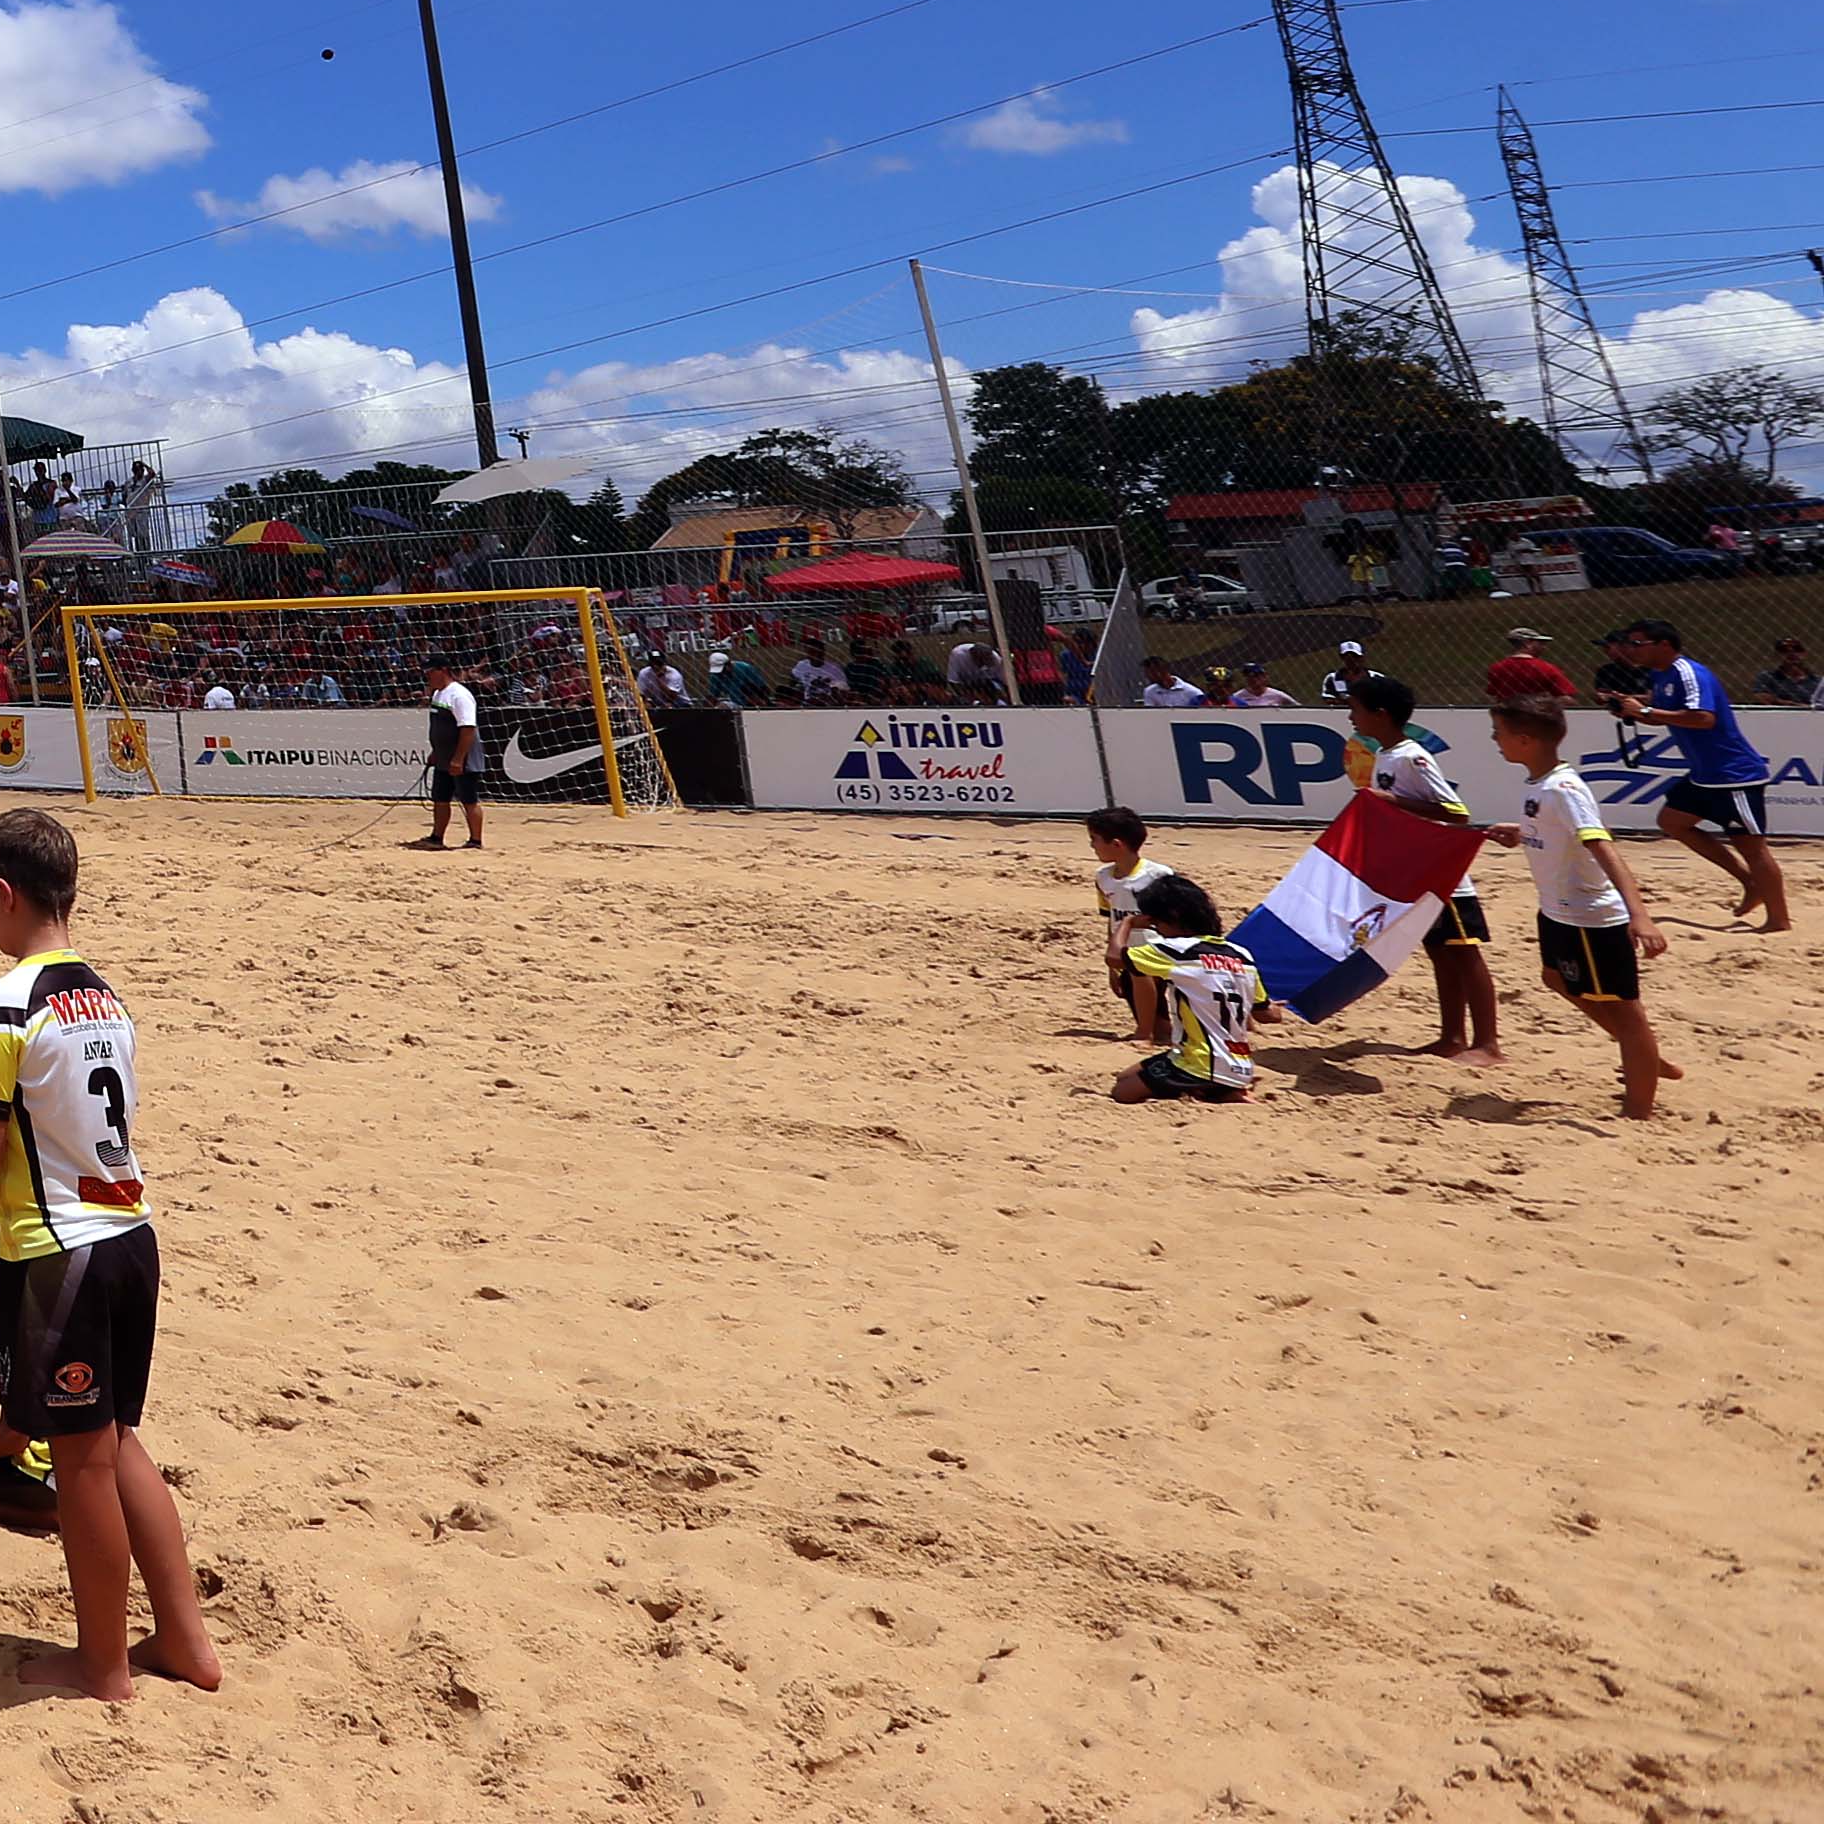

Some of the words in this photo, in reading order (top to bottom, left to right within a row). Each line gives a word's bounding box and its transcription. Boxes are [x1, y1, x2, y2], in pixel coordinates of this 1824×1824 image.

[247, 749, 315, 766] ITAIPU
[918, 753, 1006, 781] travel
[836, 783, 881, 804] (45)
[889, 785, 1016, 803] 3523-6202
[46, 987, 124, 1027] MARA
[87, 1065, 130, 1167] 3
